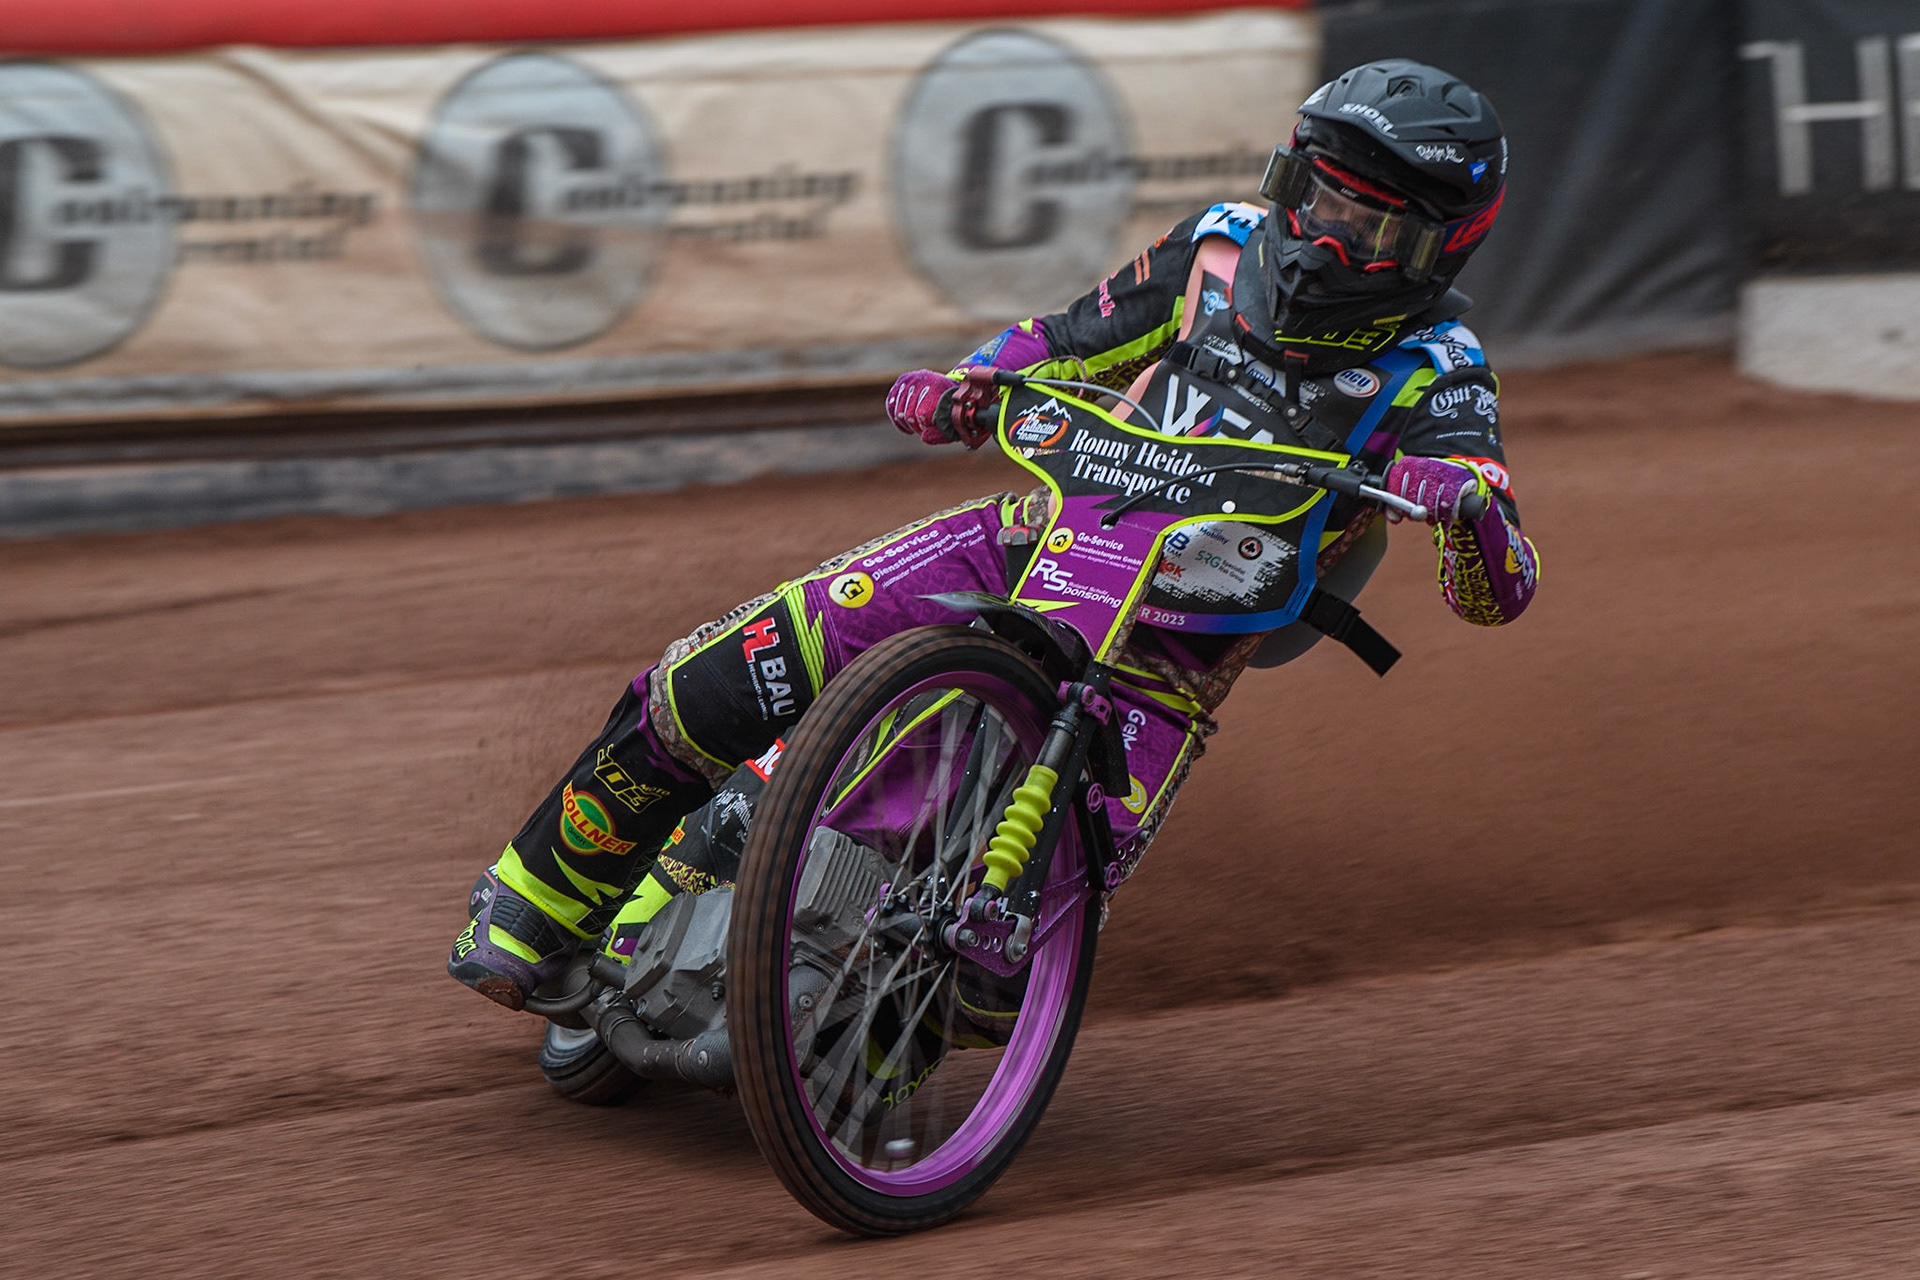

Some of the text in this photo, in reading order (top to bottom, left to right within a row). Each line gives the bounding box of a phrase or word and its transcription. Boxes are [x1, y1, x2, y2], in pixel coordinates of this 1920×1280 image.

[1340, 370, 1372, 388] ACU
[1068, 428, 1217, 487] Ronny Heiden
[1071, 453, 1192, 505] Transporte
[1076, 531, 1124, 551] Ge-Service
[1200, 525, 1231, 545] Mobility
[862, 529, 940, 567] Ge-Service
[871, 533, 953, 581] Dienstleistungen
[1071, 543, 1122, 561] Dienstleistungen
[1122, 555, 1143, 566] GmbH
[1195, 550, 1222, 569] SRG
[1152, 611, 1187, 626] 2023
[760, 655, 796, 717] BAU
